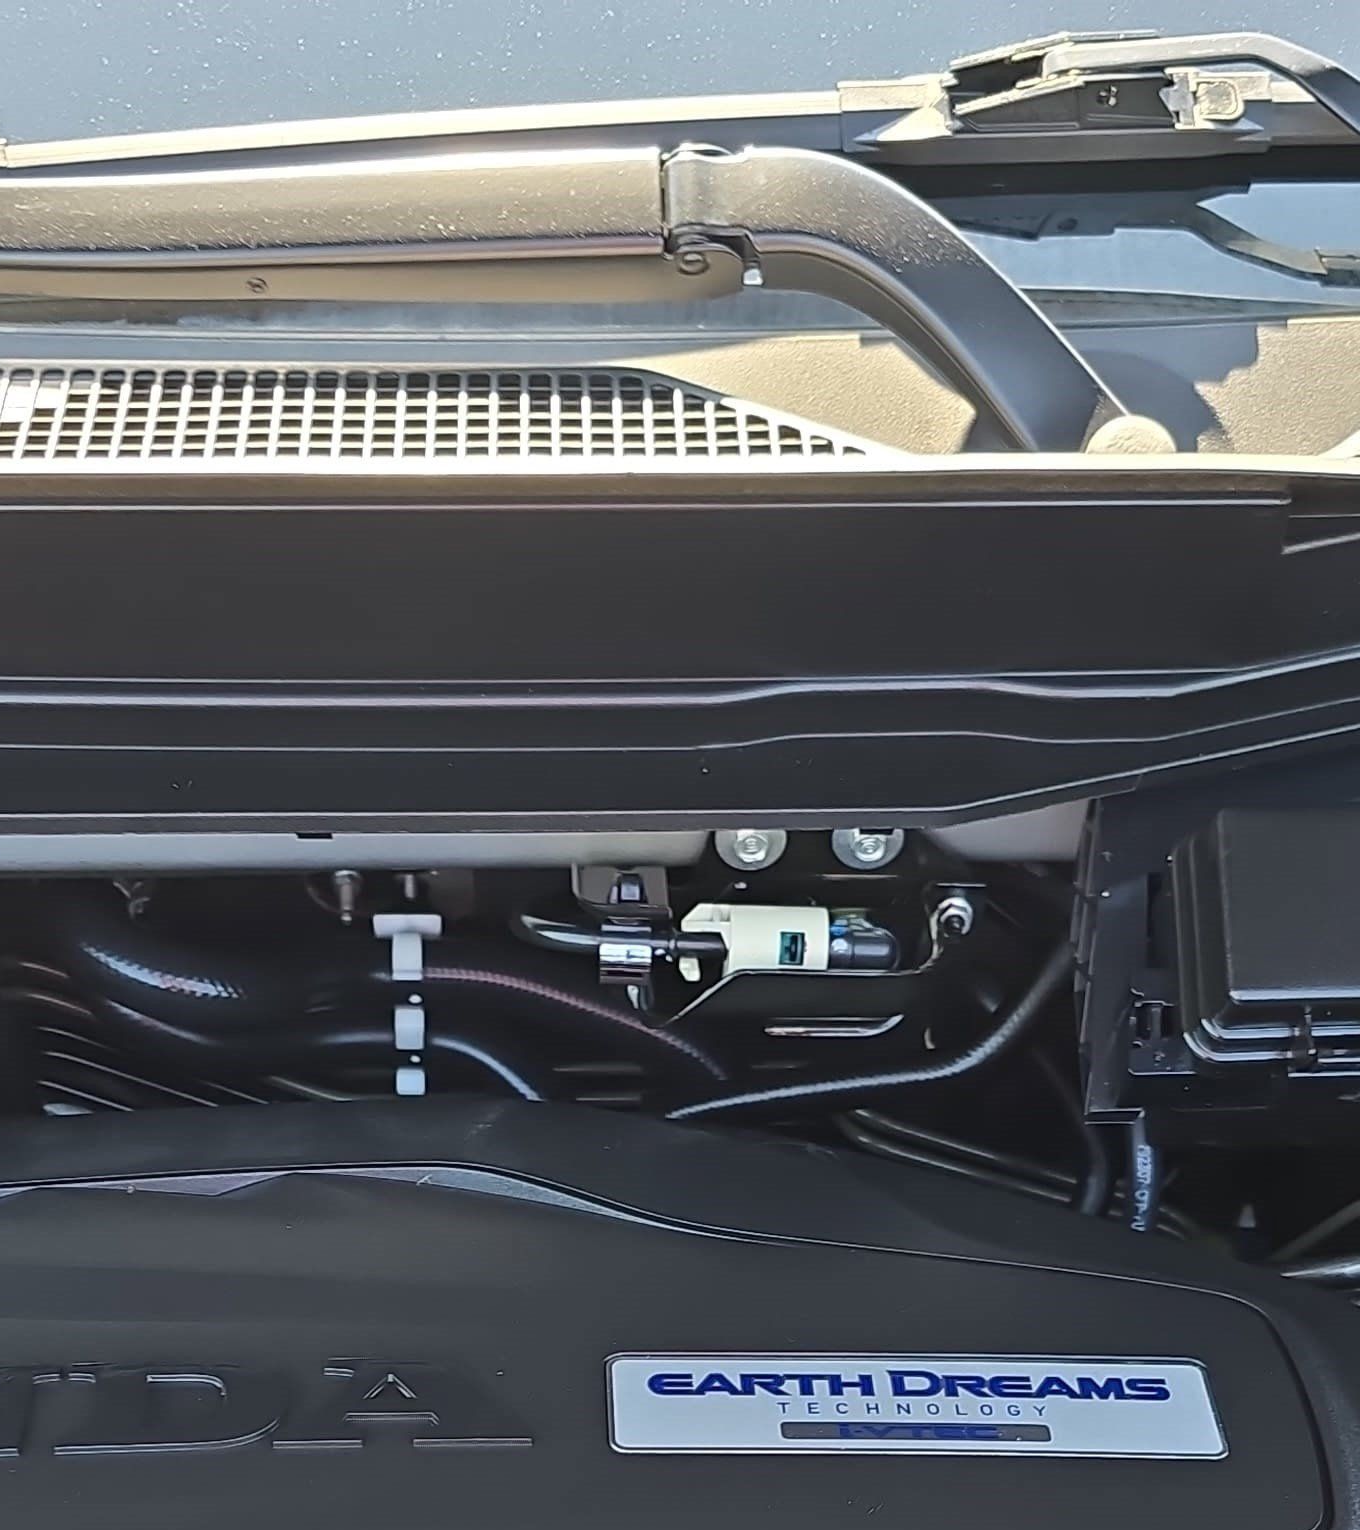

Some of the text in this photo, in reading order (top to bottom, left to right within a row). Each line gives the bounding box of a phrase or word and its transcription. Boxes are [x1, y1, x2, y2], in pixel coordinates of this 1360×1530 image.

[647, 1369, 1171, 1401] EARTH DREAMS
[777, 1401, 1048, 1418] TECHNOLOGY
